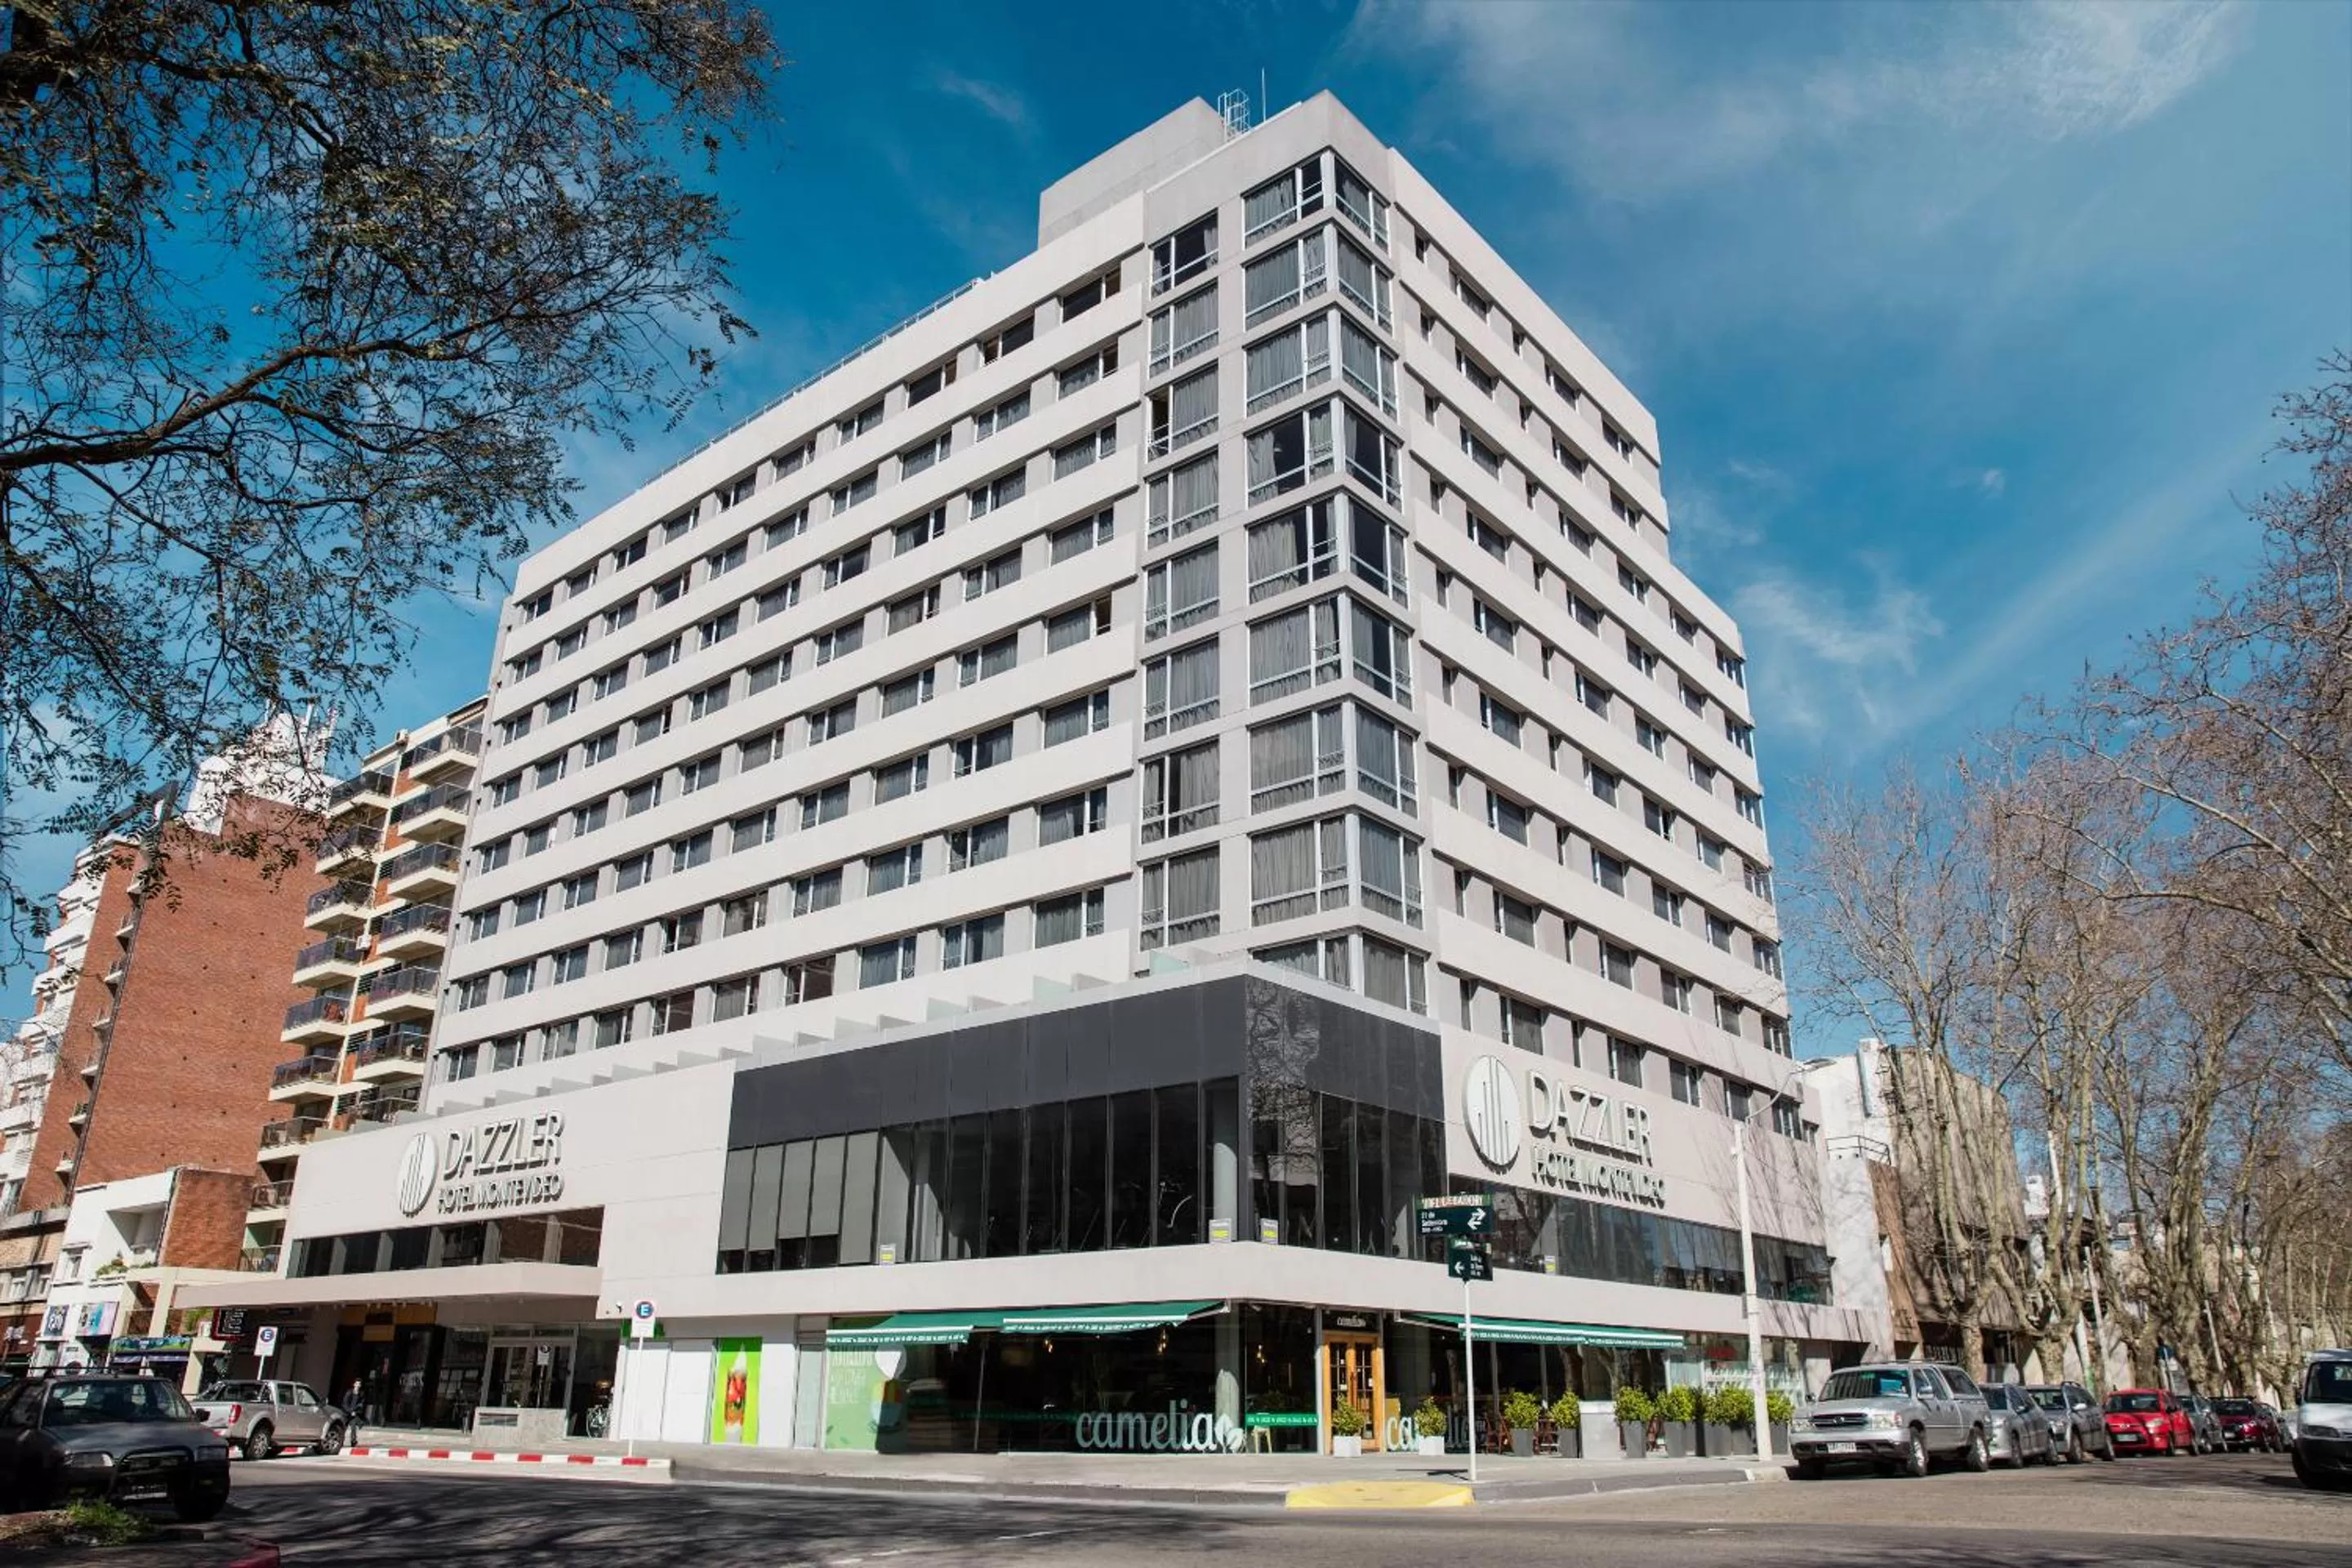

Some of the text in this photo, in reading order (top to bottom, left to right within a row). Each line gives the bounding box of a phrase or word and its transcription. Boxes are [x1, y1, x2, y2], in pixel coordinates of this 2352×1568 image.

[1527, 1070, 1653, 1166] DAZZLER
[443, 1110, 565, 1180] DAZZLER
[439, 1172, 565, 1214] HOTEL MONTEVIDEO
[1530, 1144, 1666, 1209] HOTEL MONTEVIDEO
[264, 1330, 271, 1339] E
[641, 1304, 649, 1316] E
[1076, 1399, 1217, 1450] camelia
